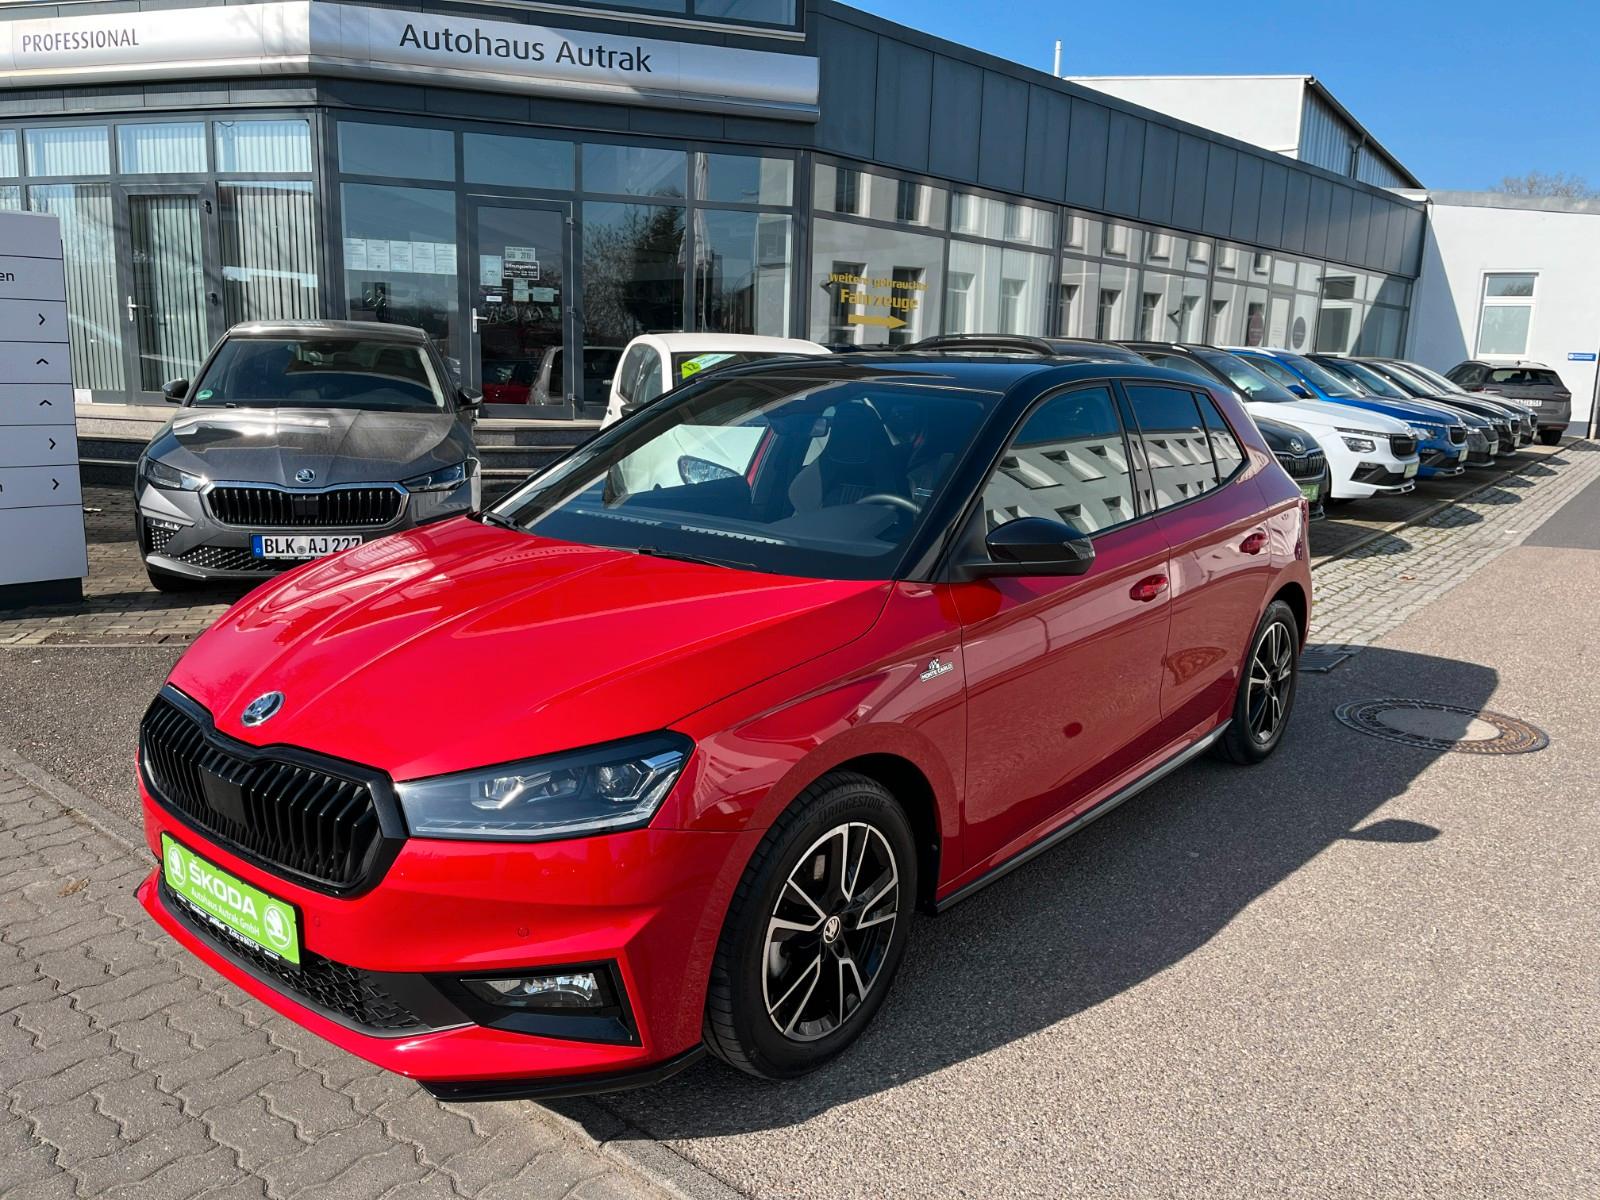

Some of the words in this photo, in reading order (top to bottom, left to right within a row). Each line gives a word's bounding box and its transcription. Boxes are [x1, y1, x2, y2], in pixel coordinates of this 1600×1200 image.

[22, 28, 139, 52] PROFESSIONAL
[399, 24, 545, 61] Autohaus
[555, 41, 652, 73] Autrak
[840, 288, 919, 313] Fahrzeuge
[264, 538, 296, 554] BLK
[308, 538, 328, 553] AJ
[189, 859, 258, 920] ŠKODA
[191, 887, 218, 912] Autohaus
[218, 904, 240, 926] Autrak
[239, 918, 260, 937] GmbH
